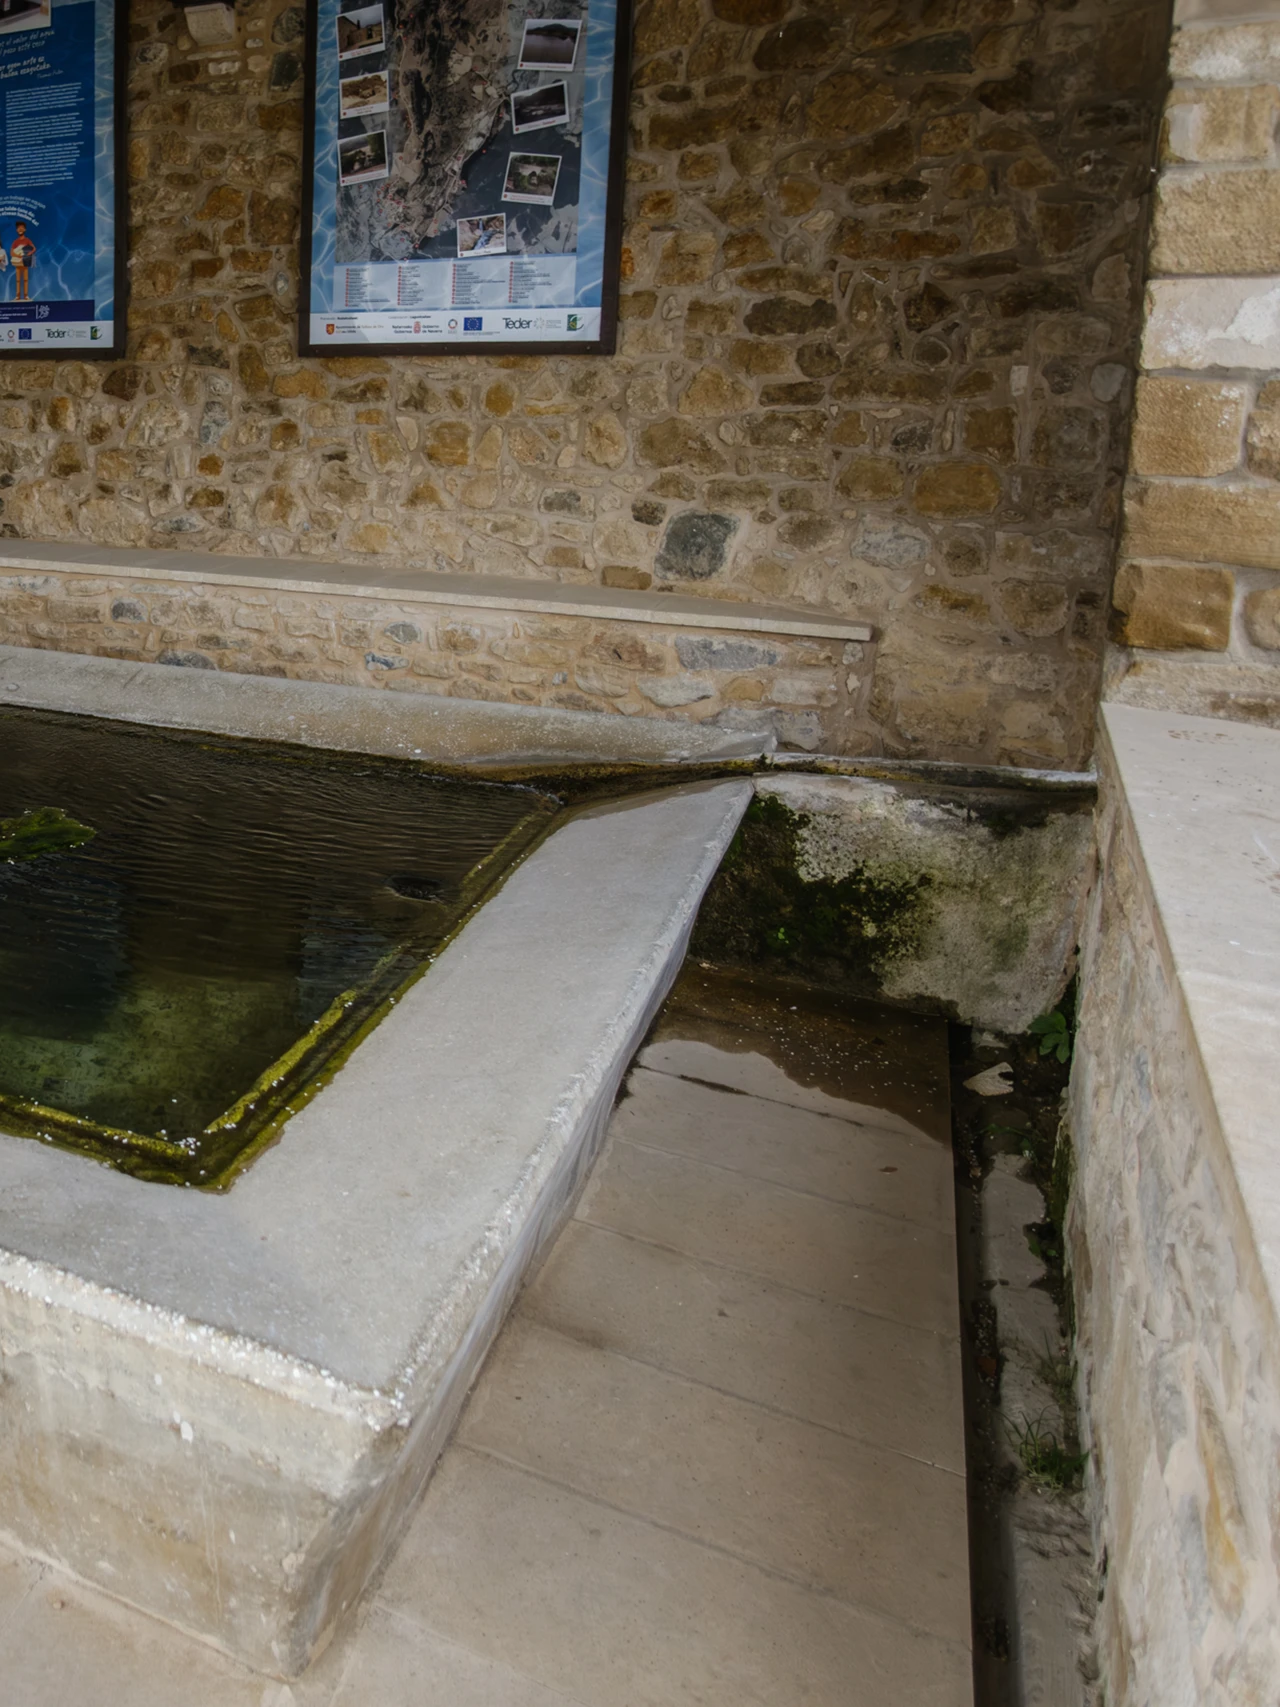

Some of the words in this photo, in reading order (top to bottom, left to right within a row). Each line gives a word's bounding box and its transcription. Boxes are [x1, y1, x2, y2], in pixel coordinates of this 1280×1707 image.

[12, 34, 28, 44] valor
[29, 31, 39, 40] del
[40, 29, 55, 39] agua
[3, 47, 17, 57] pozo
[23, 57, 37, 66] arte
[502, 317, 533, 329] Teder
[45, 328, 67, 338] Teder
